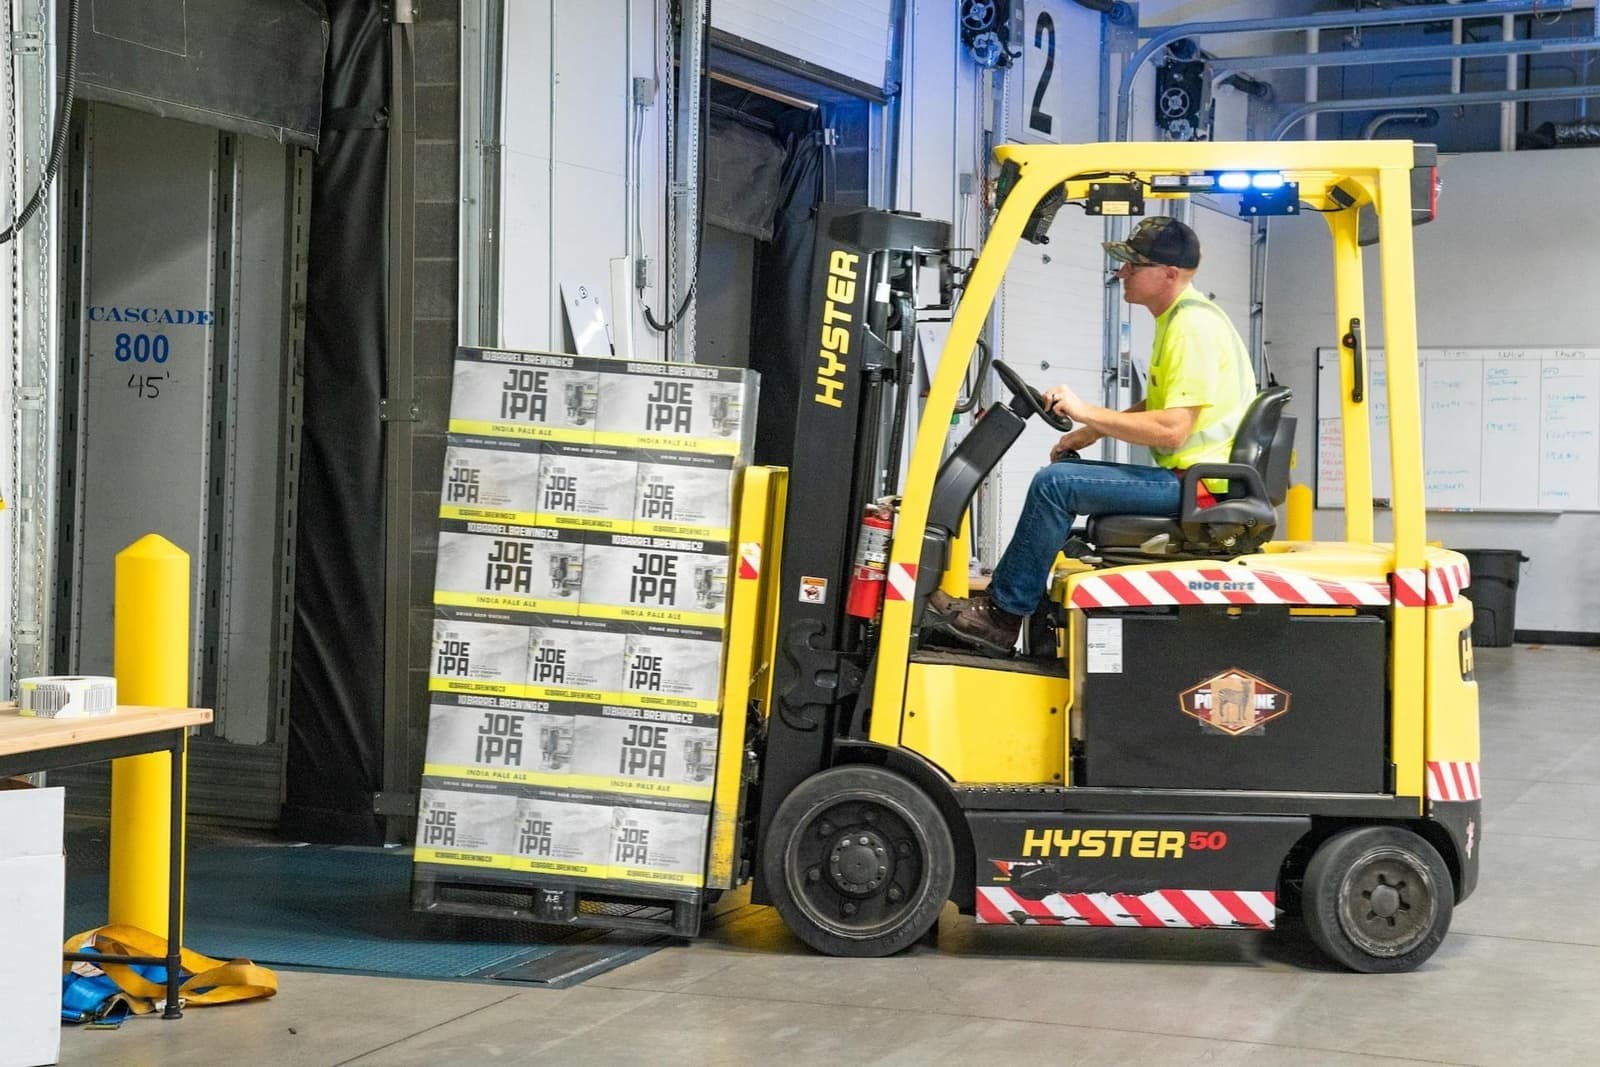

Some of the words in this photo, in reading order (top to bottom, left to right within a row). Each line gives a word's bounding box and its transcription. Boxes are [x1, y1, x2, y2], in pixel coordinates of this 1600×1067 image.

[1029, 11, 1055, 135] 2
[88, 306, 214, 326] CASCADE
[815, 250, 859, 408] HYSTER
[115, 333, 169, 363] 800
[503, 369, 549, 393] JOE
[648, 380, 693, 405] JOE
[500, 392, 547, 422] IPA
[646, 403, 692, 433] IPA
[491, 425, 514, 433] INDIA
[449, 467, 480, 484] JOE
[546, 475, 577, 492] JOE
[447, 483, 479, 503] IPA
[544, 491, 576, 511] IPA
[643, 483, 675, 500] JOE
[641, 499, 673, 520] IPA
[488, 540, 534, 565] JOE
[632, 552, 678, 577] JOE
[485, 563, 532, 593] IPA
[1188, 581, 1220, 591] RIDE
[476, 596, 499, 604] INDIA
[502, 598, 520, 606] PALE
[630, 575, 676, 606] IPA
[621, 608, 644, 617] INDIA
[439, 640, 470, 657] JOE
[535, 647, 566, 664] JOE
[437, 656, 469, 676] IPA
[631, 654, 663, 671] JOE
[533, 663, 565, 684] IPA
[629, 670, 661, 691] IPA
[478, 713, 524, 738] JOE
[622, 724, 668, 749] JOE
[475, 735, 522, 766] IPA
[619, 747, 666, 777] IPA
[466, 769, 489, 777] INDIA
[492, 771, 510, 779] PALE
[610, 780, 633, 788] INDIA
[636, 782, 654, 790] PALE
[425, 810, 457, 827] JOE
[521, 819, 553, 836] JOE
[423, 825, 456, 846] IPA
[519, 835, 551, 856] IPA
[618, 827, 649, 844] JOE
[1022, 829, 1185, 858] HYSTER
[1188, 831, 1227, 850] 50
[615, 843, 647, 864] IPA
